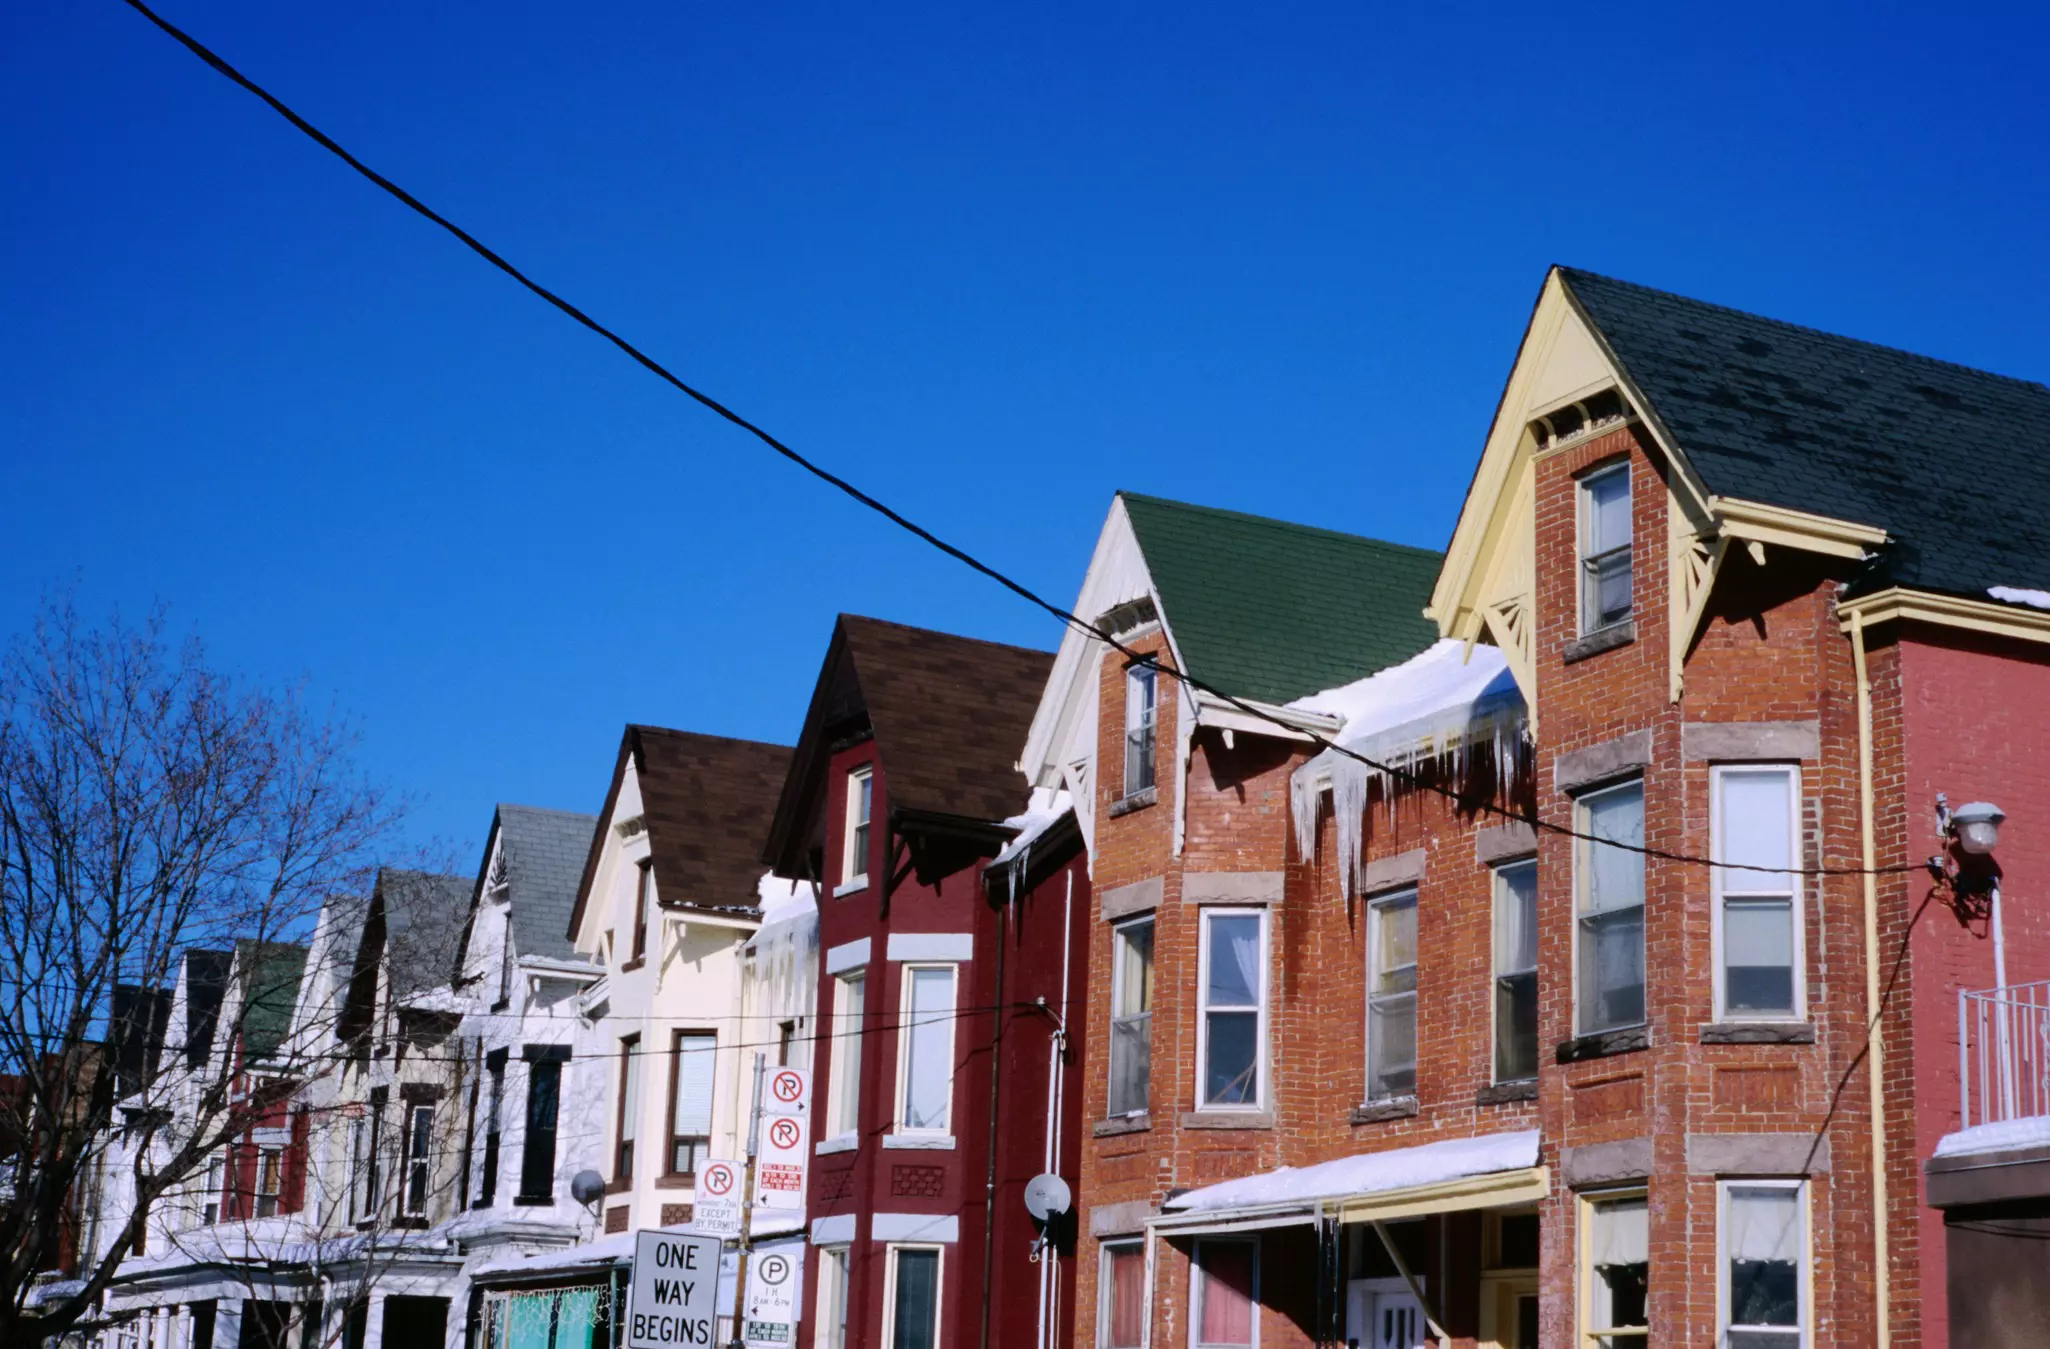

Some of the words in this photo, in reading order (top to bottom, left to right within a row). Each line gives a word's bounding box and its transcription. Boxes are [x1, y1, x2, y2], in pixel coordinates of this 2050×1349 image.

[783, 1079, 796, 1096] P
[779, 1124, 792, 1141] P
[713, 1171, 727, 1188] P
[701, 1208, 731, 1219] EXCEPT
[695, 1219, 706, 1229] BY
[708, 1219, 736, 1231] PERMIT
[656, 1242, 699, 1270] ONE
[768, 1262, 782, 1278] P
[654, 1278, 695, 1306] WAY
[633, 1313, 709, 1344] BEGINS
